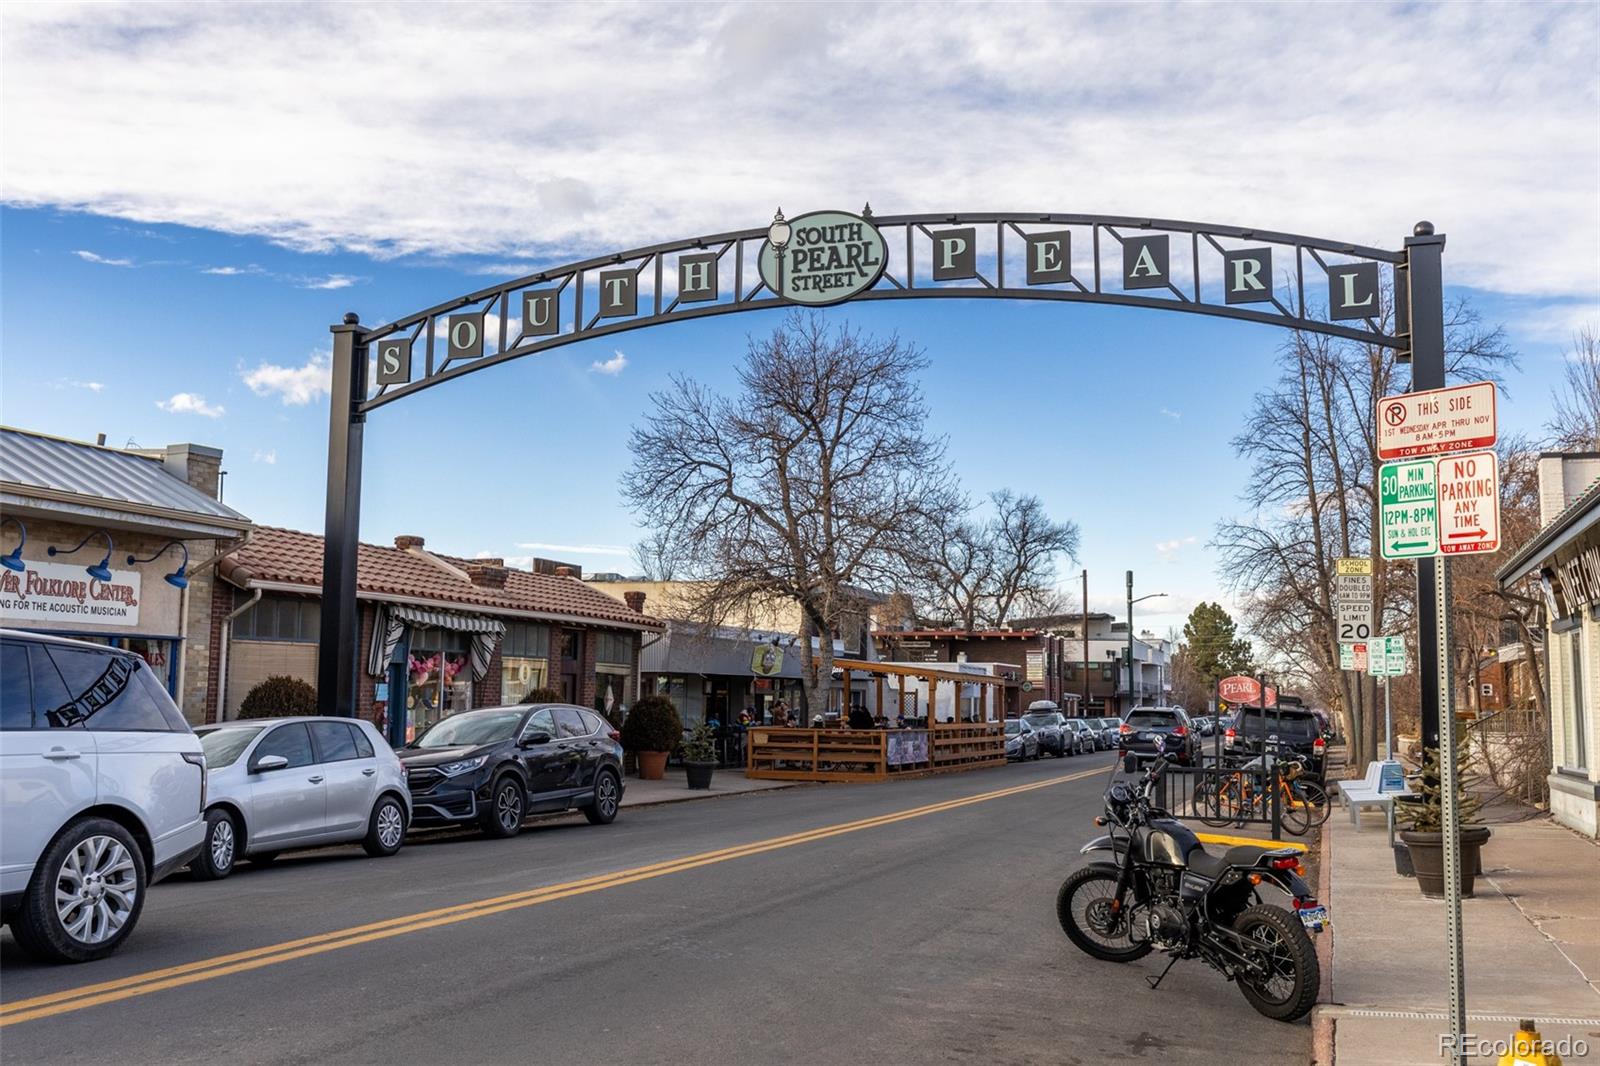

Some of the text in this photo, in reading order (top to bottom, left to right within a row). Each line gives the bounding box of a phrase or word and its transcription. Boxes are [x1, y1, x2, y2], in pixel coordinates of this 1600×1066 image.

[796, 222, 863, 247] SOUTH
[791, 241, 880, 278] PEARL
[791, 271, 856, 293] STREET
[1417, 396, 1472, 416] THIS SIDE
[1384, 415, 1490, 437] 1ST WEDNESDAY APR THRU NOV
[1399, 440, 1473, 456] TOW AWAY ZONE
[1454, 459, 1476, 480] NO
[1382, 467, 1424, 496] 30 MIN
[1441, 478, 1492, 501] PARKING
[1399, 482, 1434, 499] PARKING
[1454, 500, 1478, 514] ANY
[1453, 514, 1480, 528] TIME
[1387, 529, 1399, 539] SUN
[1407, 527, 1419, 537] HOL
[1420, 526, 1431, 537] EXC
[1458, 543, 1475, 552] AWAY
[1477, 541, 1494, 550] ZONE
[13, 601, 29, 610] FOR
[32, 602, 47, 611] THE
[49, 604, 89, 614] ACOUSTIC
[90, 607, 127, 616] MUSICIAN
[1340, 604, 1370, 612] SPEED
[1341, 624, 1370, 639] 20
[1223, 682, 1257, 696] PEARL
